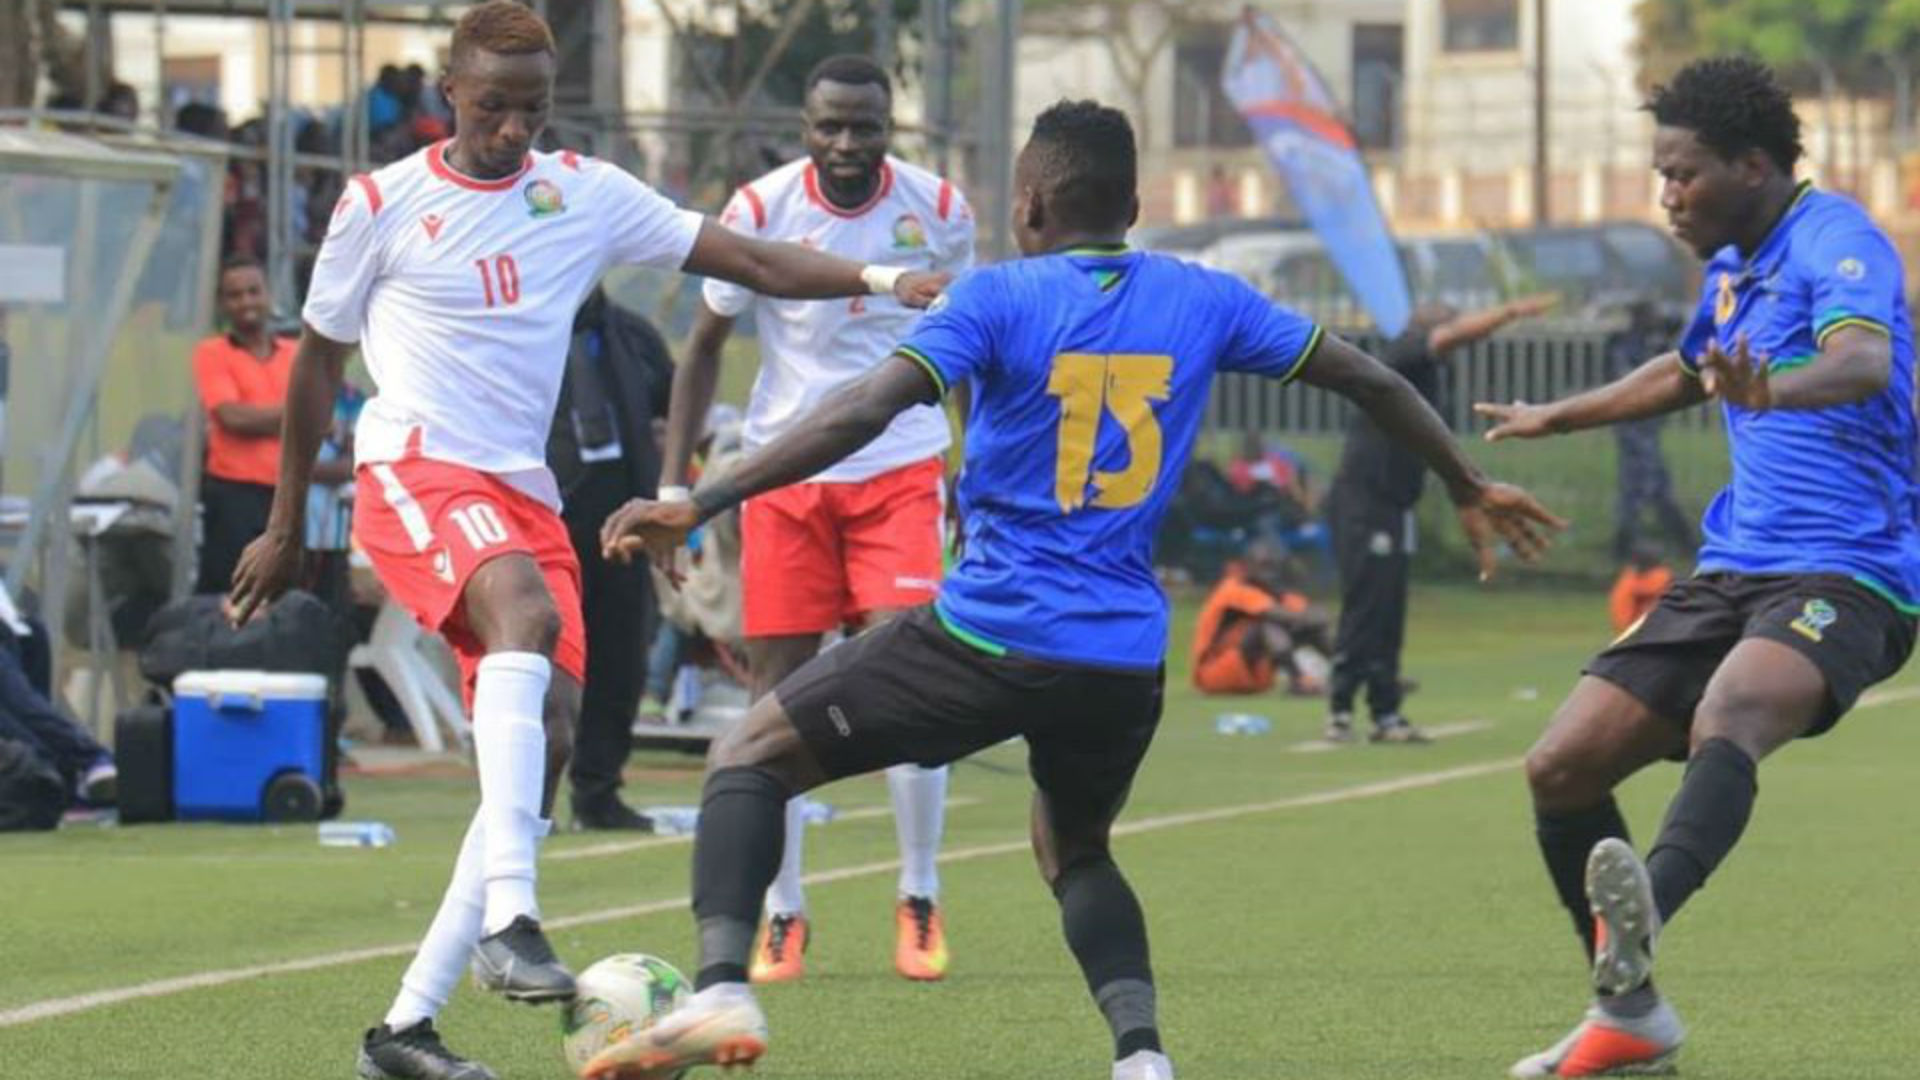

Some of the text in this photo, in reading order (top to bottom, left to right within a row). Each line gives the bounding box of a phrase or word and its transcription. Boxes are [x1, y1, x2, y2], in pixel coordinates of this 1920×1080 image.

[475, 255, 519, 308] 10
[1046, 353, 1173, 514] 15
[450, 503, 508, 551] 10
